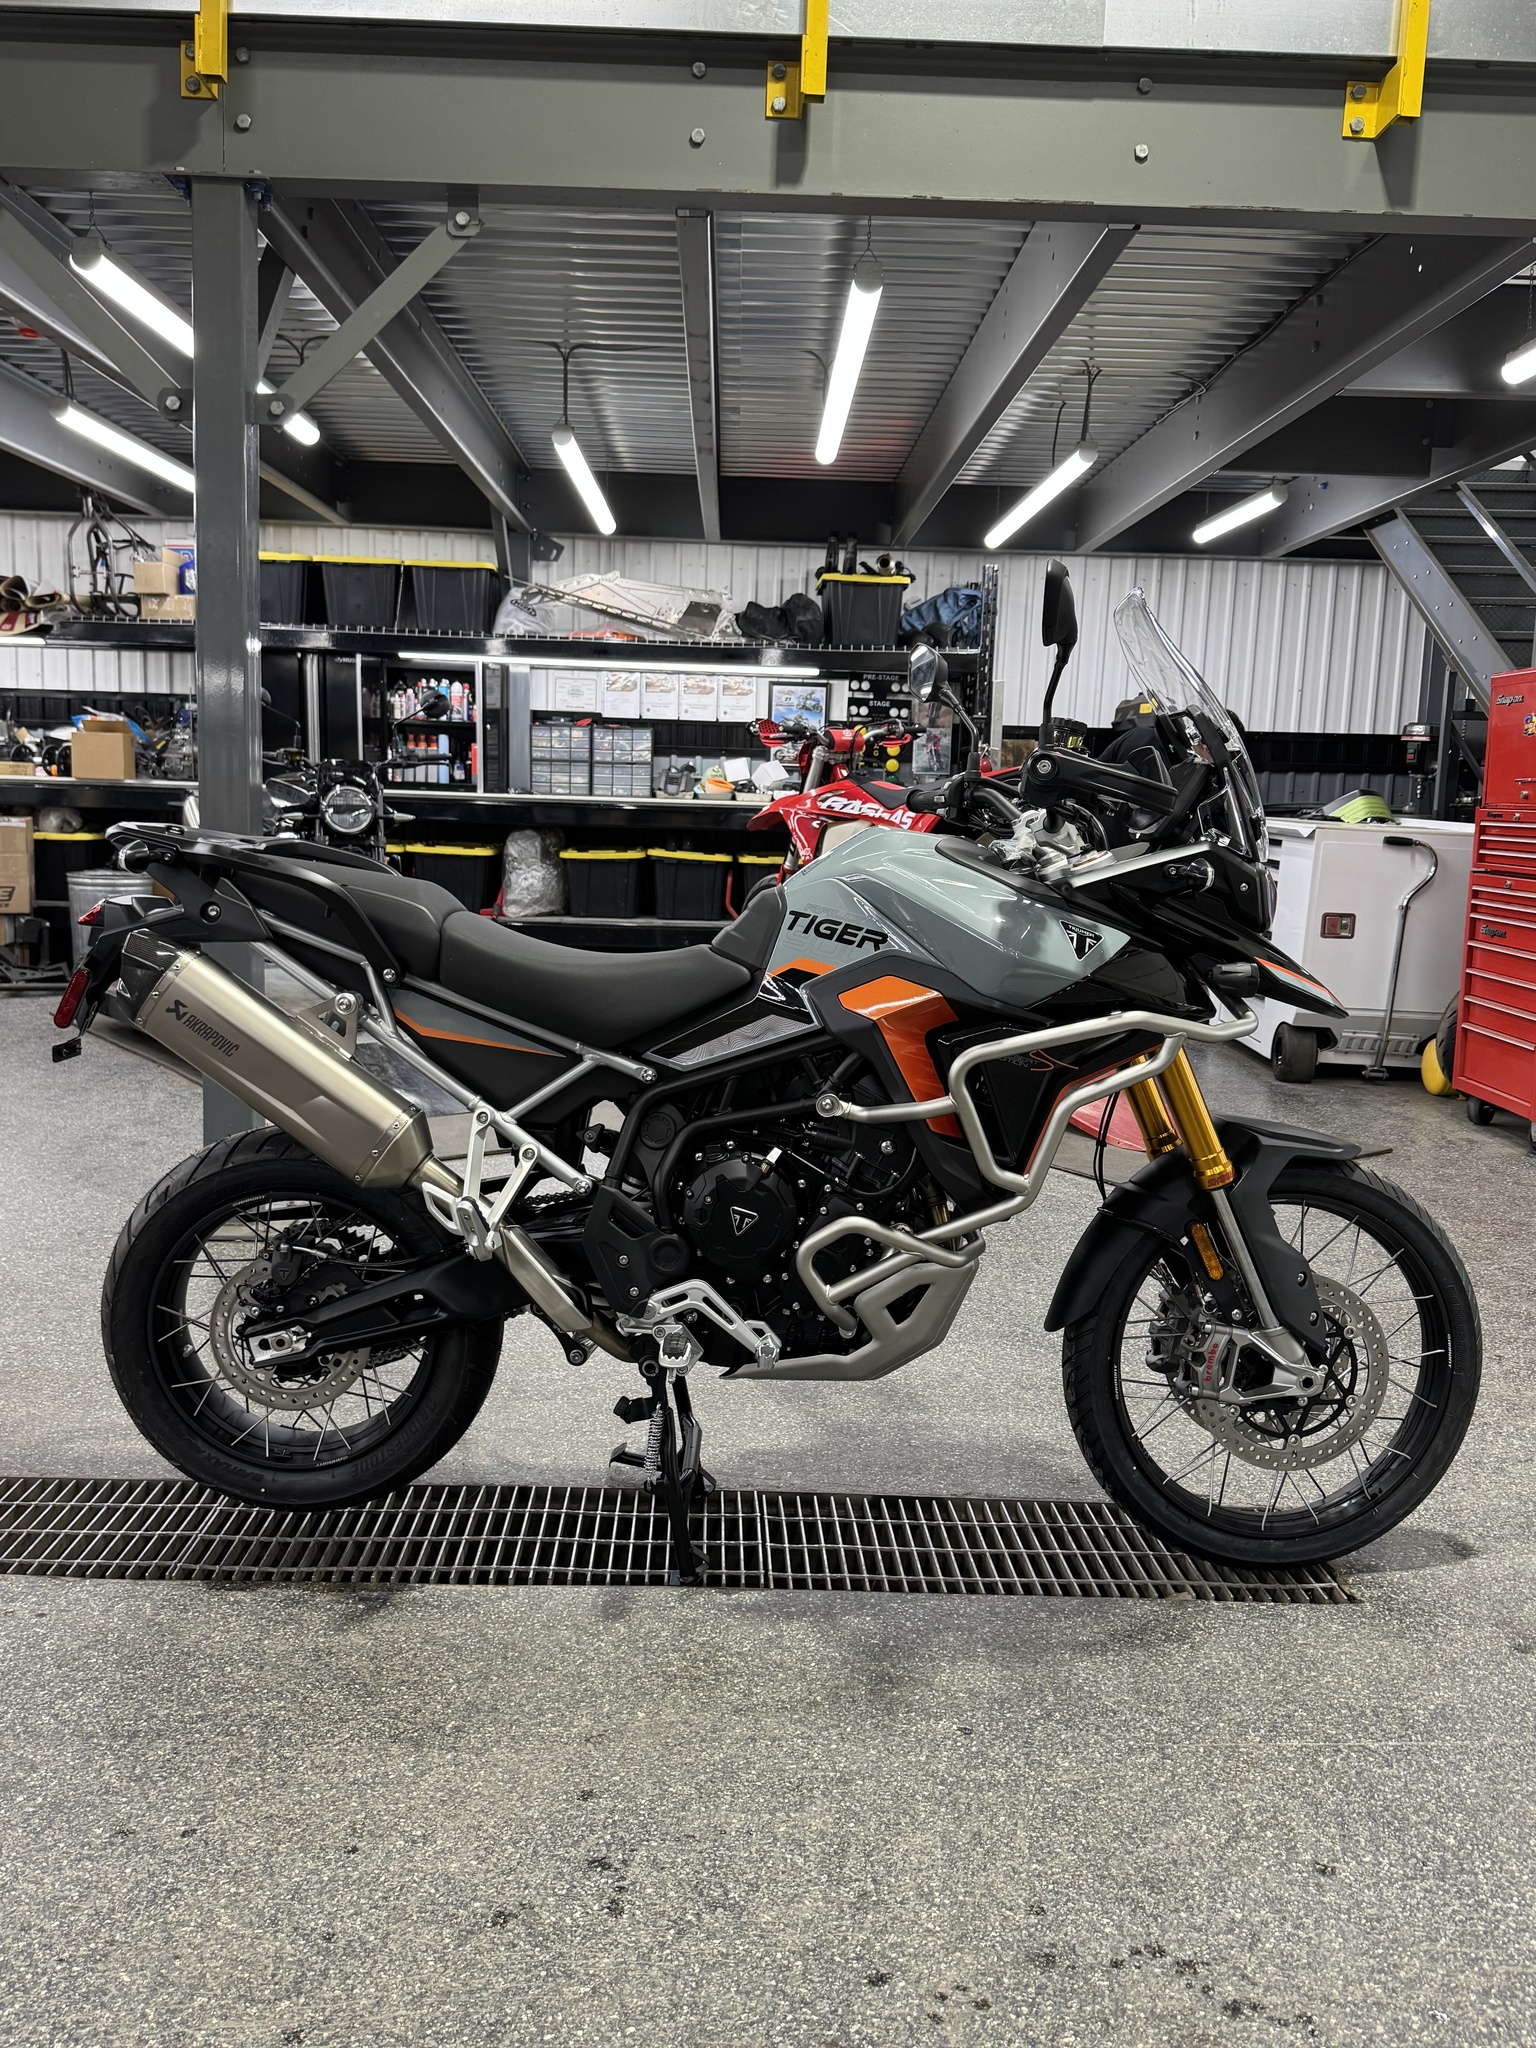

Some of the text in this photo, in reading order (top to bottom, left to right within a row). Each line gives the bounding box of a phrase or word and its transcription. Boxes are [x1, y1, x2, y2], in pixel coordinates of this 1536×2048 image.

[863, 673, 900, 681] PRE-STAGE
[1496, 694, 1524, 706] Snap-on
[787, 910, 889, 952] TIGER
[1068, 924, 1095, 938] TRIUMPH
[182, 1014, 240, 1058] AKRAPOVIČ
[1203, 1342, 1219, 1382] brembo
